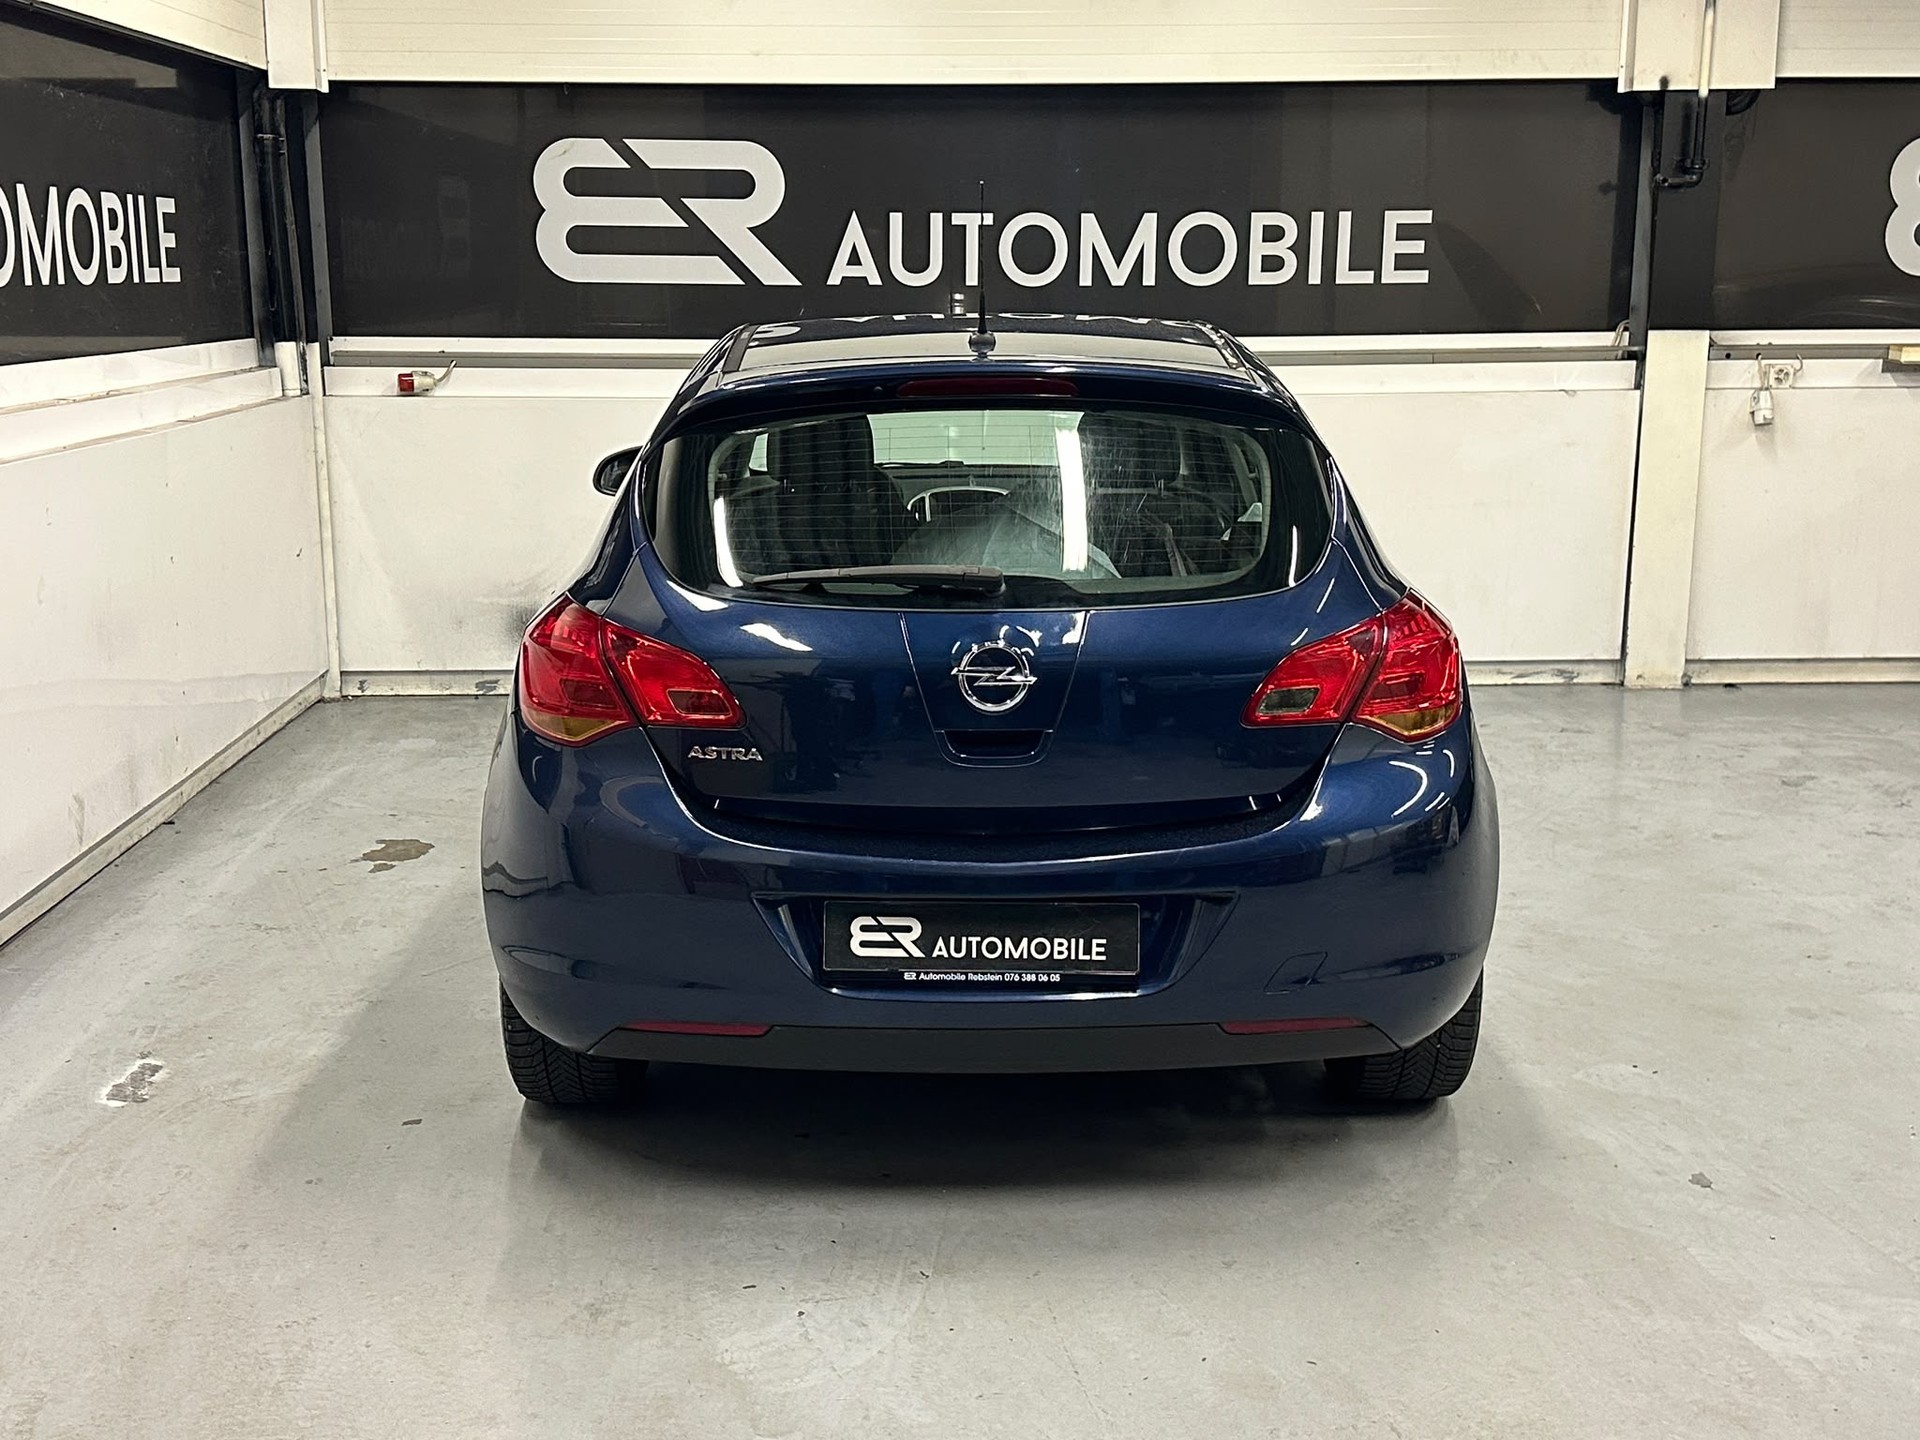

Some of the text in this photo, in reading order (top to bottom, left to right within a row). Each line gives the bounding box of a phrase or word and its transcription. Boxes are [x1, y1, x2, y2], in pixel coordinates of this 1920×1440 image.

[827, 210, 1433, 287] AUTOMOBILE
[688, 746, 763, 761] ASTRA
[931, 936, 1107, 961] AUTOMOBILE
[918, 972, 967, 982] Automobile
[967, 973, 1003, 982] Rebstein
[1004, 973, 1020, 982] 076
[1038, 973, 1049, 982] 06
[1050, 973, 1061, 982] 05
